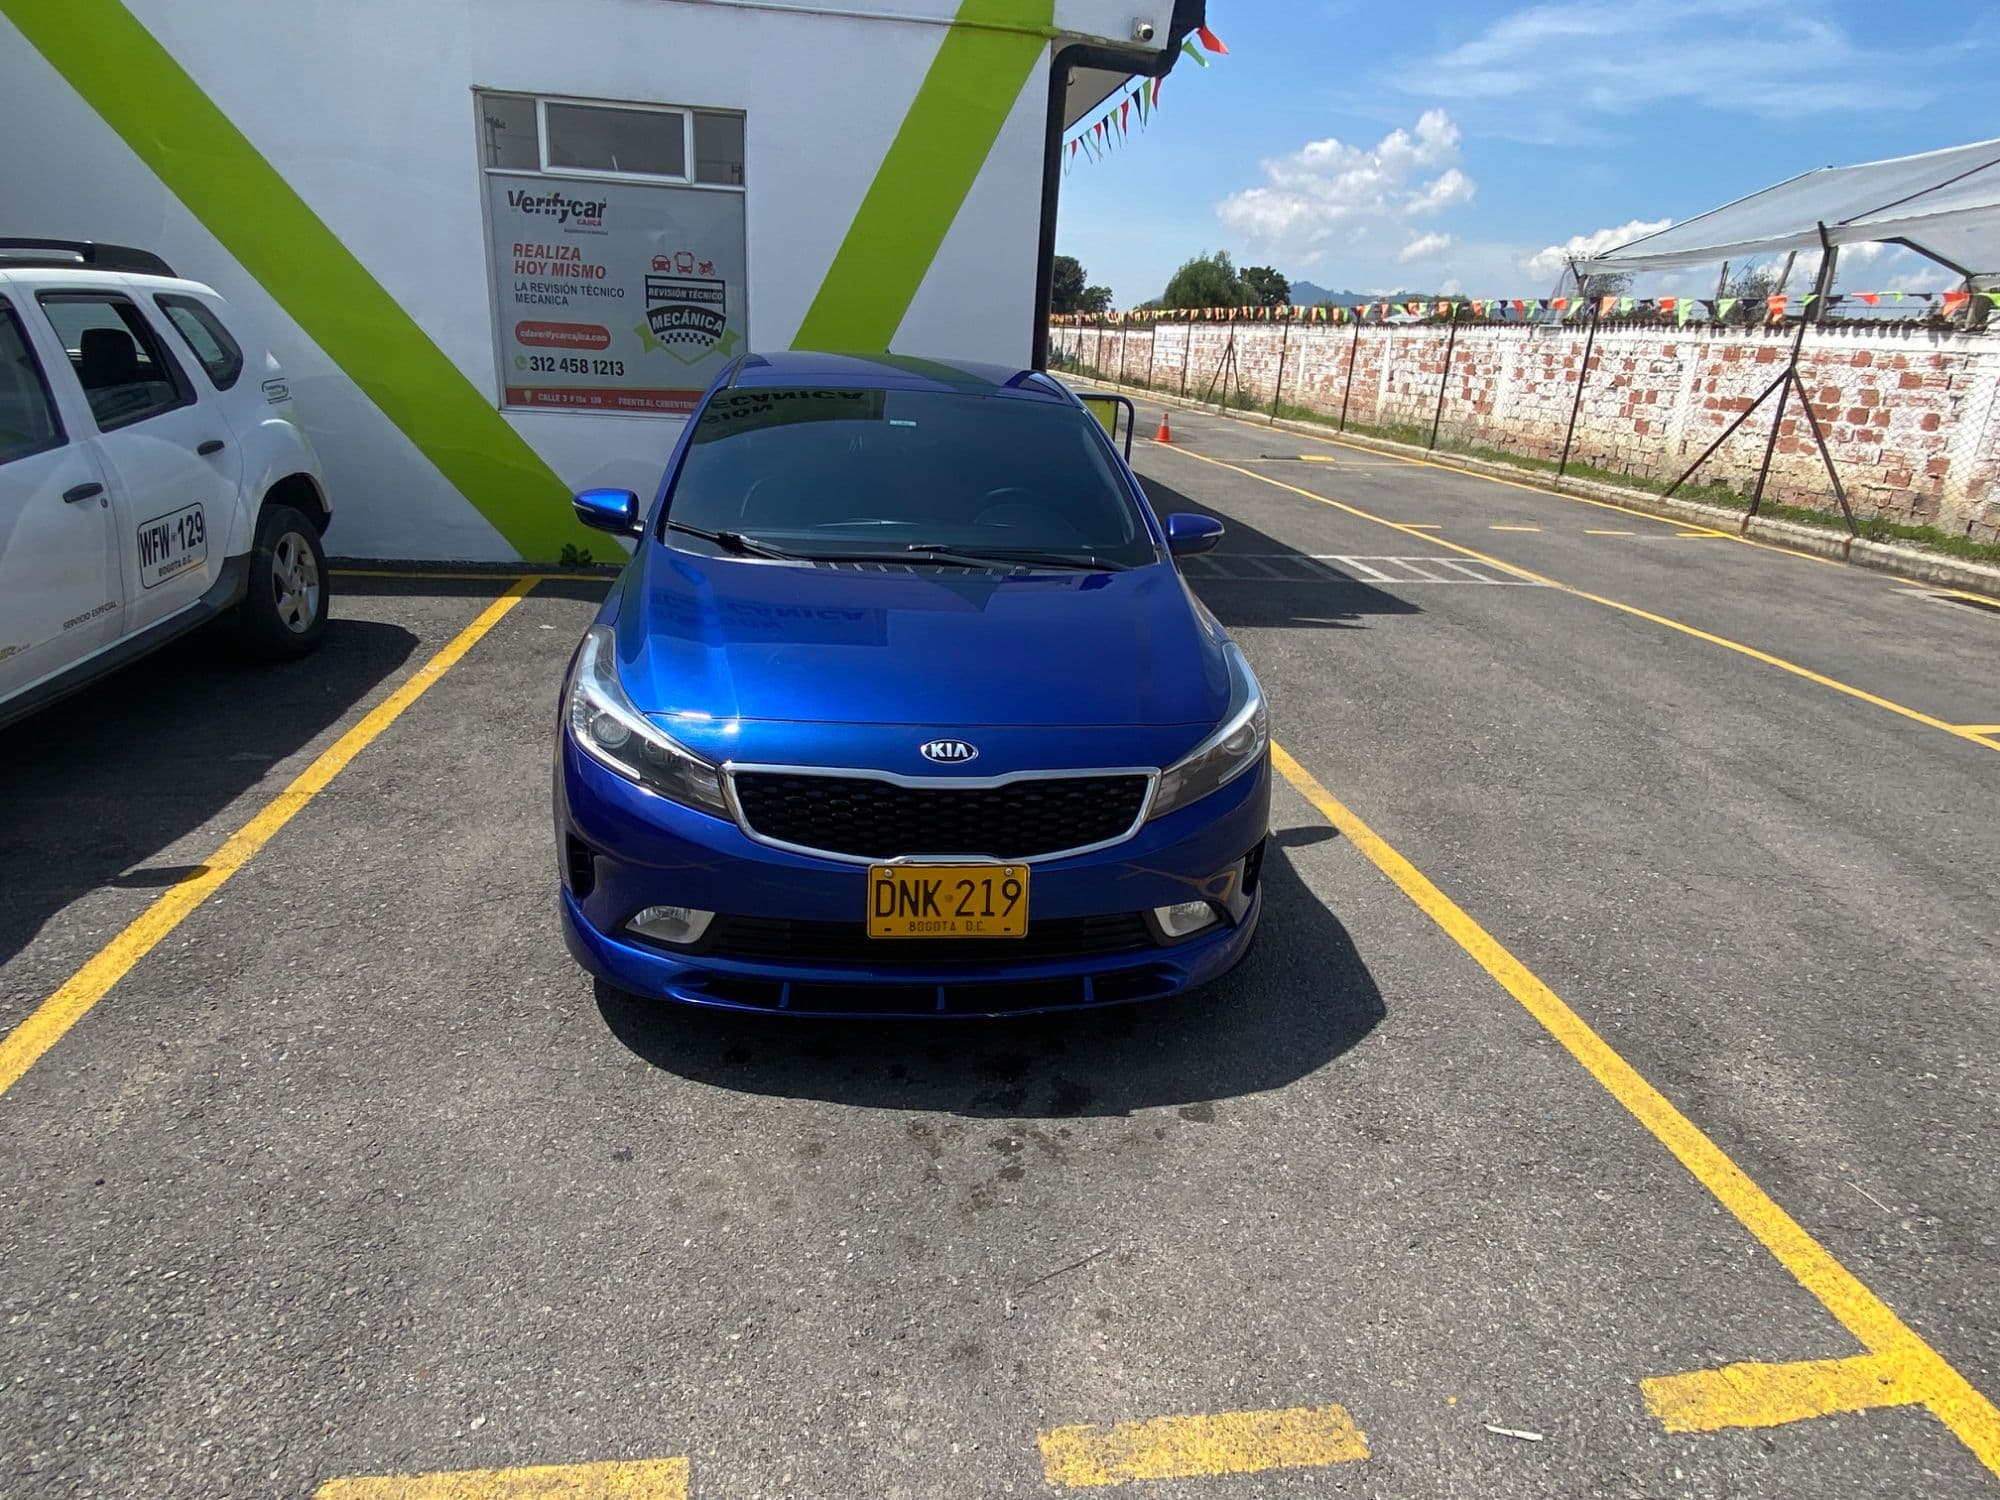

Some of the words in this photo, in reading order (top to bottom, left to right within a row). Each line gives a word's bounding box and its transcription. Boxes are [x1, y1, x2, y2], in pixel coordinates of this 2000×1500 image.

[507, 190, 607, 223] Verifycar
[513, 243, 581, 261] REALIZA
[514, 260, 547, 275] HOY
[551, 263, 606, 280] MISMO
[514, 282, 528, 292] LA
[530, 282, 578, 295] REVISIÓN
[580, 284, 625, 298] TÉCNICO
[648, 287, 687, 298] REVISIÓN
[689, 290, 724, 301] TÉCNICO
[652, 309, 724, 333] MECÁNICA
[529, 356, 556, 372] 312
[559, 358, 589, 374] 458
[592, 360, 625, 376] 1213
[538, 393, 560, 402] CALLE
[178, 511, 204, 550] 129
[930, 743, 968, 758] KIA
[875, 879, 942, 918] DNK
[954, 879, 1022, 917] 219
[909, 921, 957, 932] BOGOTA
